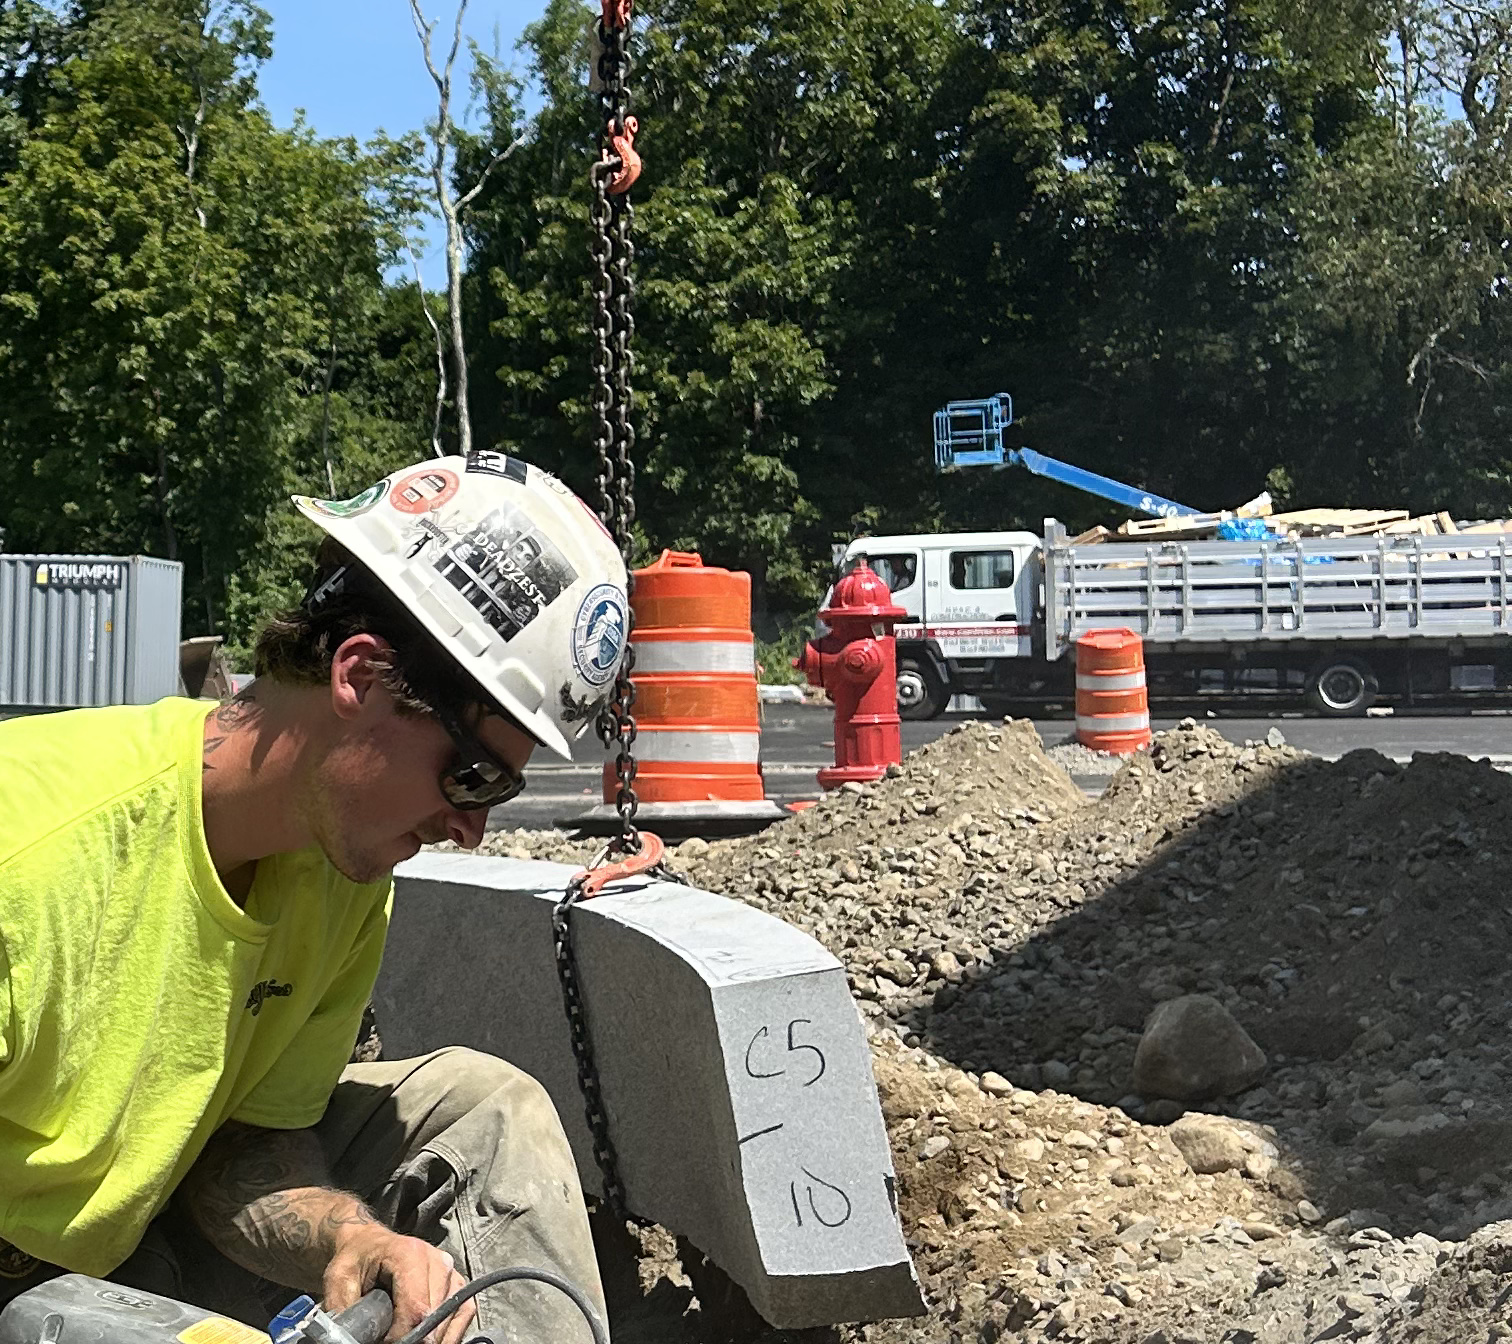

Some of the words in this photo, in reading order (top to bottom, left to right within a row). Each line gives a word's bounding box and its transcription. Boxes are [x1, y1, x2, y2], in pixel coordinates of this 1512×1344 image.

[49, 564, 119, 579] TRIUMPH
[473, 533, 548, 608] DEADZEST
[745, 1019, 826, 1087] C5
[791, 1166, 852, 1228] 10
